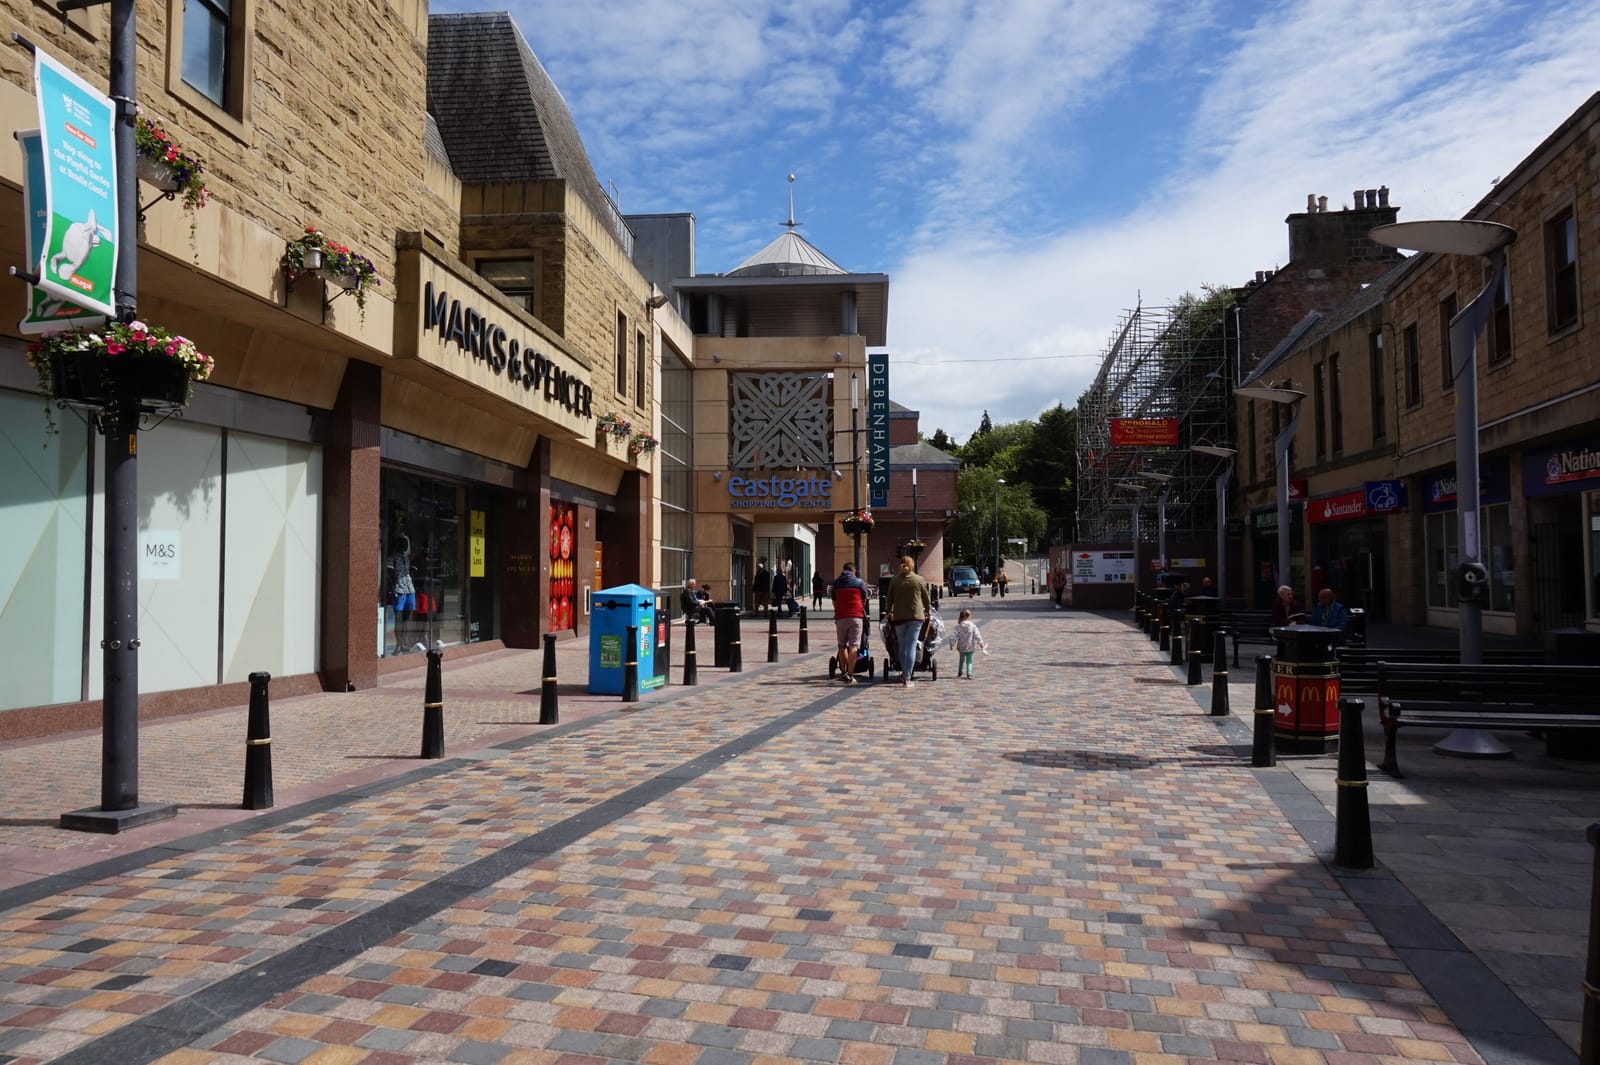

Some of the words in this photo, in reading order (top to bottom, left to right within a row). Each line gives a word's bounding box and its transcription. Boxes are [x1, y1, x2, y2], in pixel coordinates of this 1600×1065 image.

[54, 148, 65, 161] the
[89, 170, 110, 188] Garden
[59, 165, 67, 175] at
[424, 281, 507, 376] MARKS
[507, 338, 522, 383] &
[522, 347, 593, 419] SPENCER
[873, 364, 885, 484] DEBENHAMS
[728, 474, 832, 509] eastgate
[731, 500, 777, 509] SHOPPING
[800, 500, 832, 509] CENTRE
[1332, 498, 1362, 515] Santander
[146, 543, 175, 558] M&S
